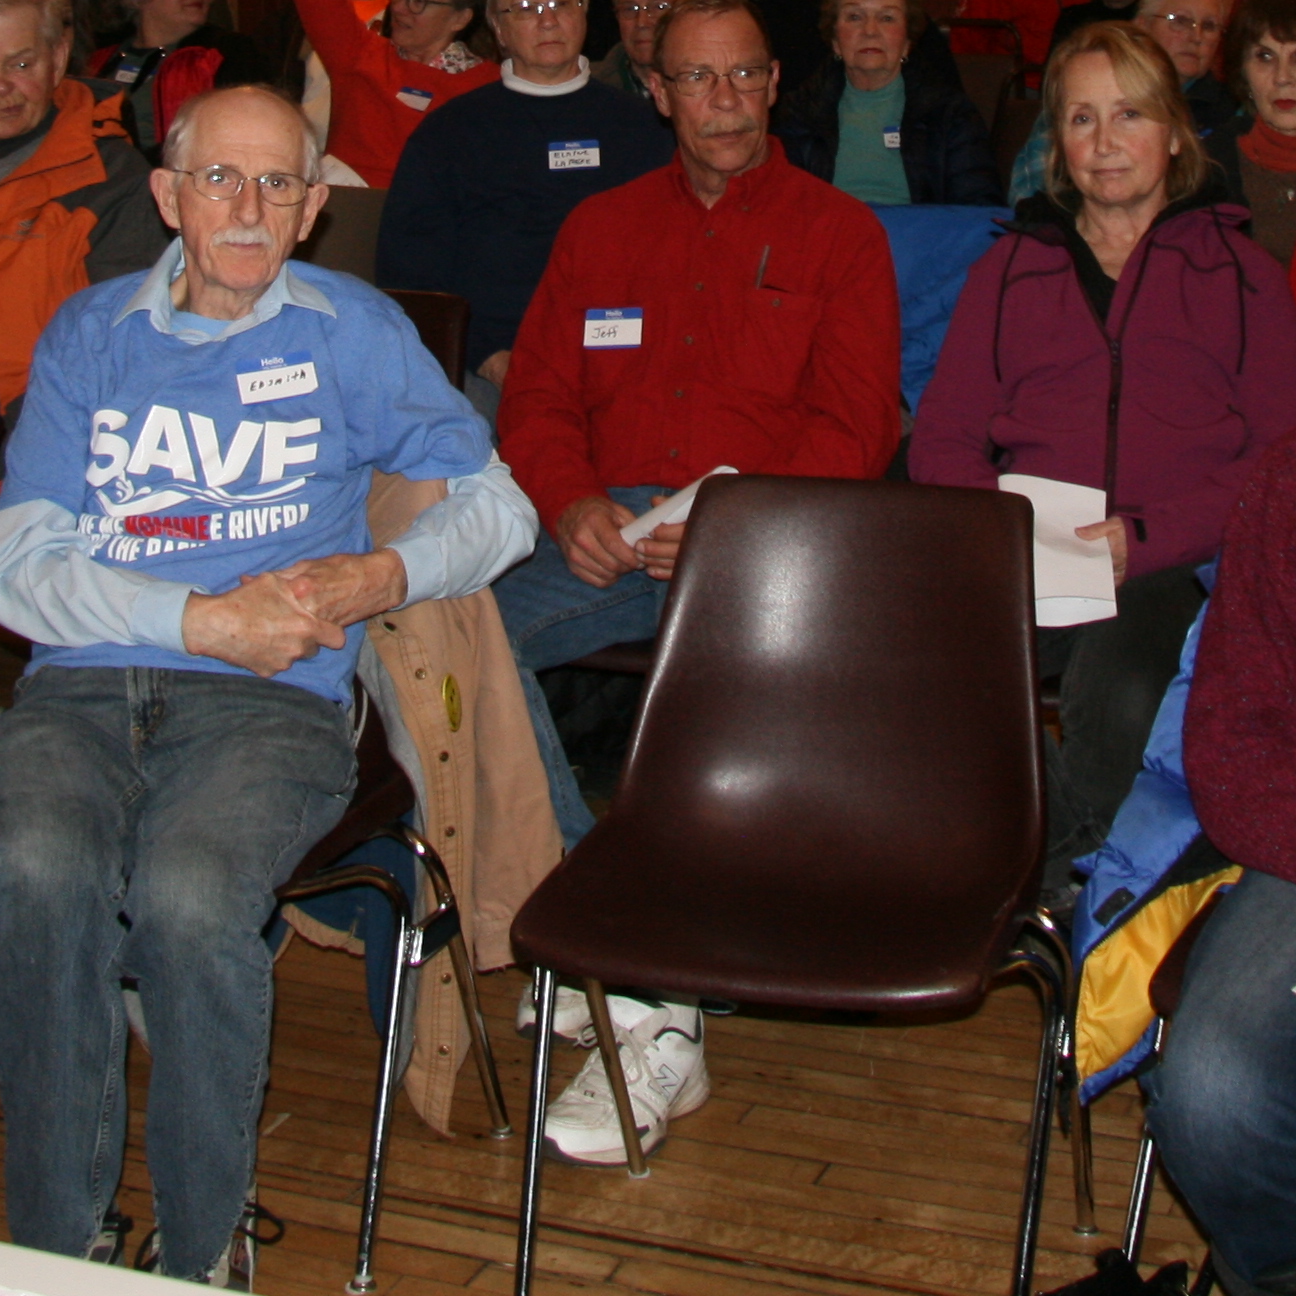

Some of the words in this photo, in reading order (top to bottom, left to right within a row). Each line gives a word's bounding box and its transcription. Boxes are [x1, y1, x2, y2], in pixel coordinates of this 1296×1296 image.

[591, 325, 629, 339] Jeff
[260, 357, 285, 367] Hello
[107, 534, 145, 562] THE
